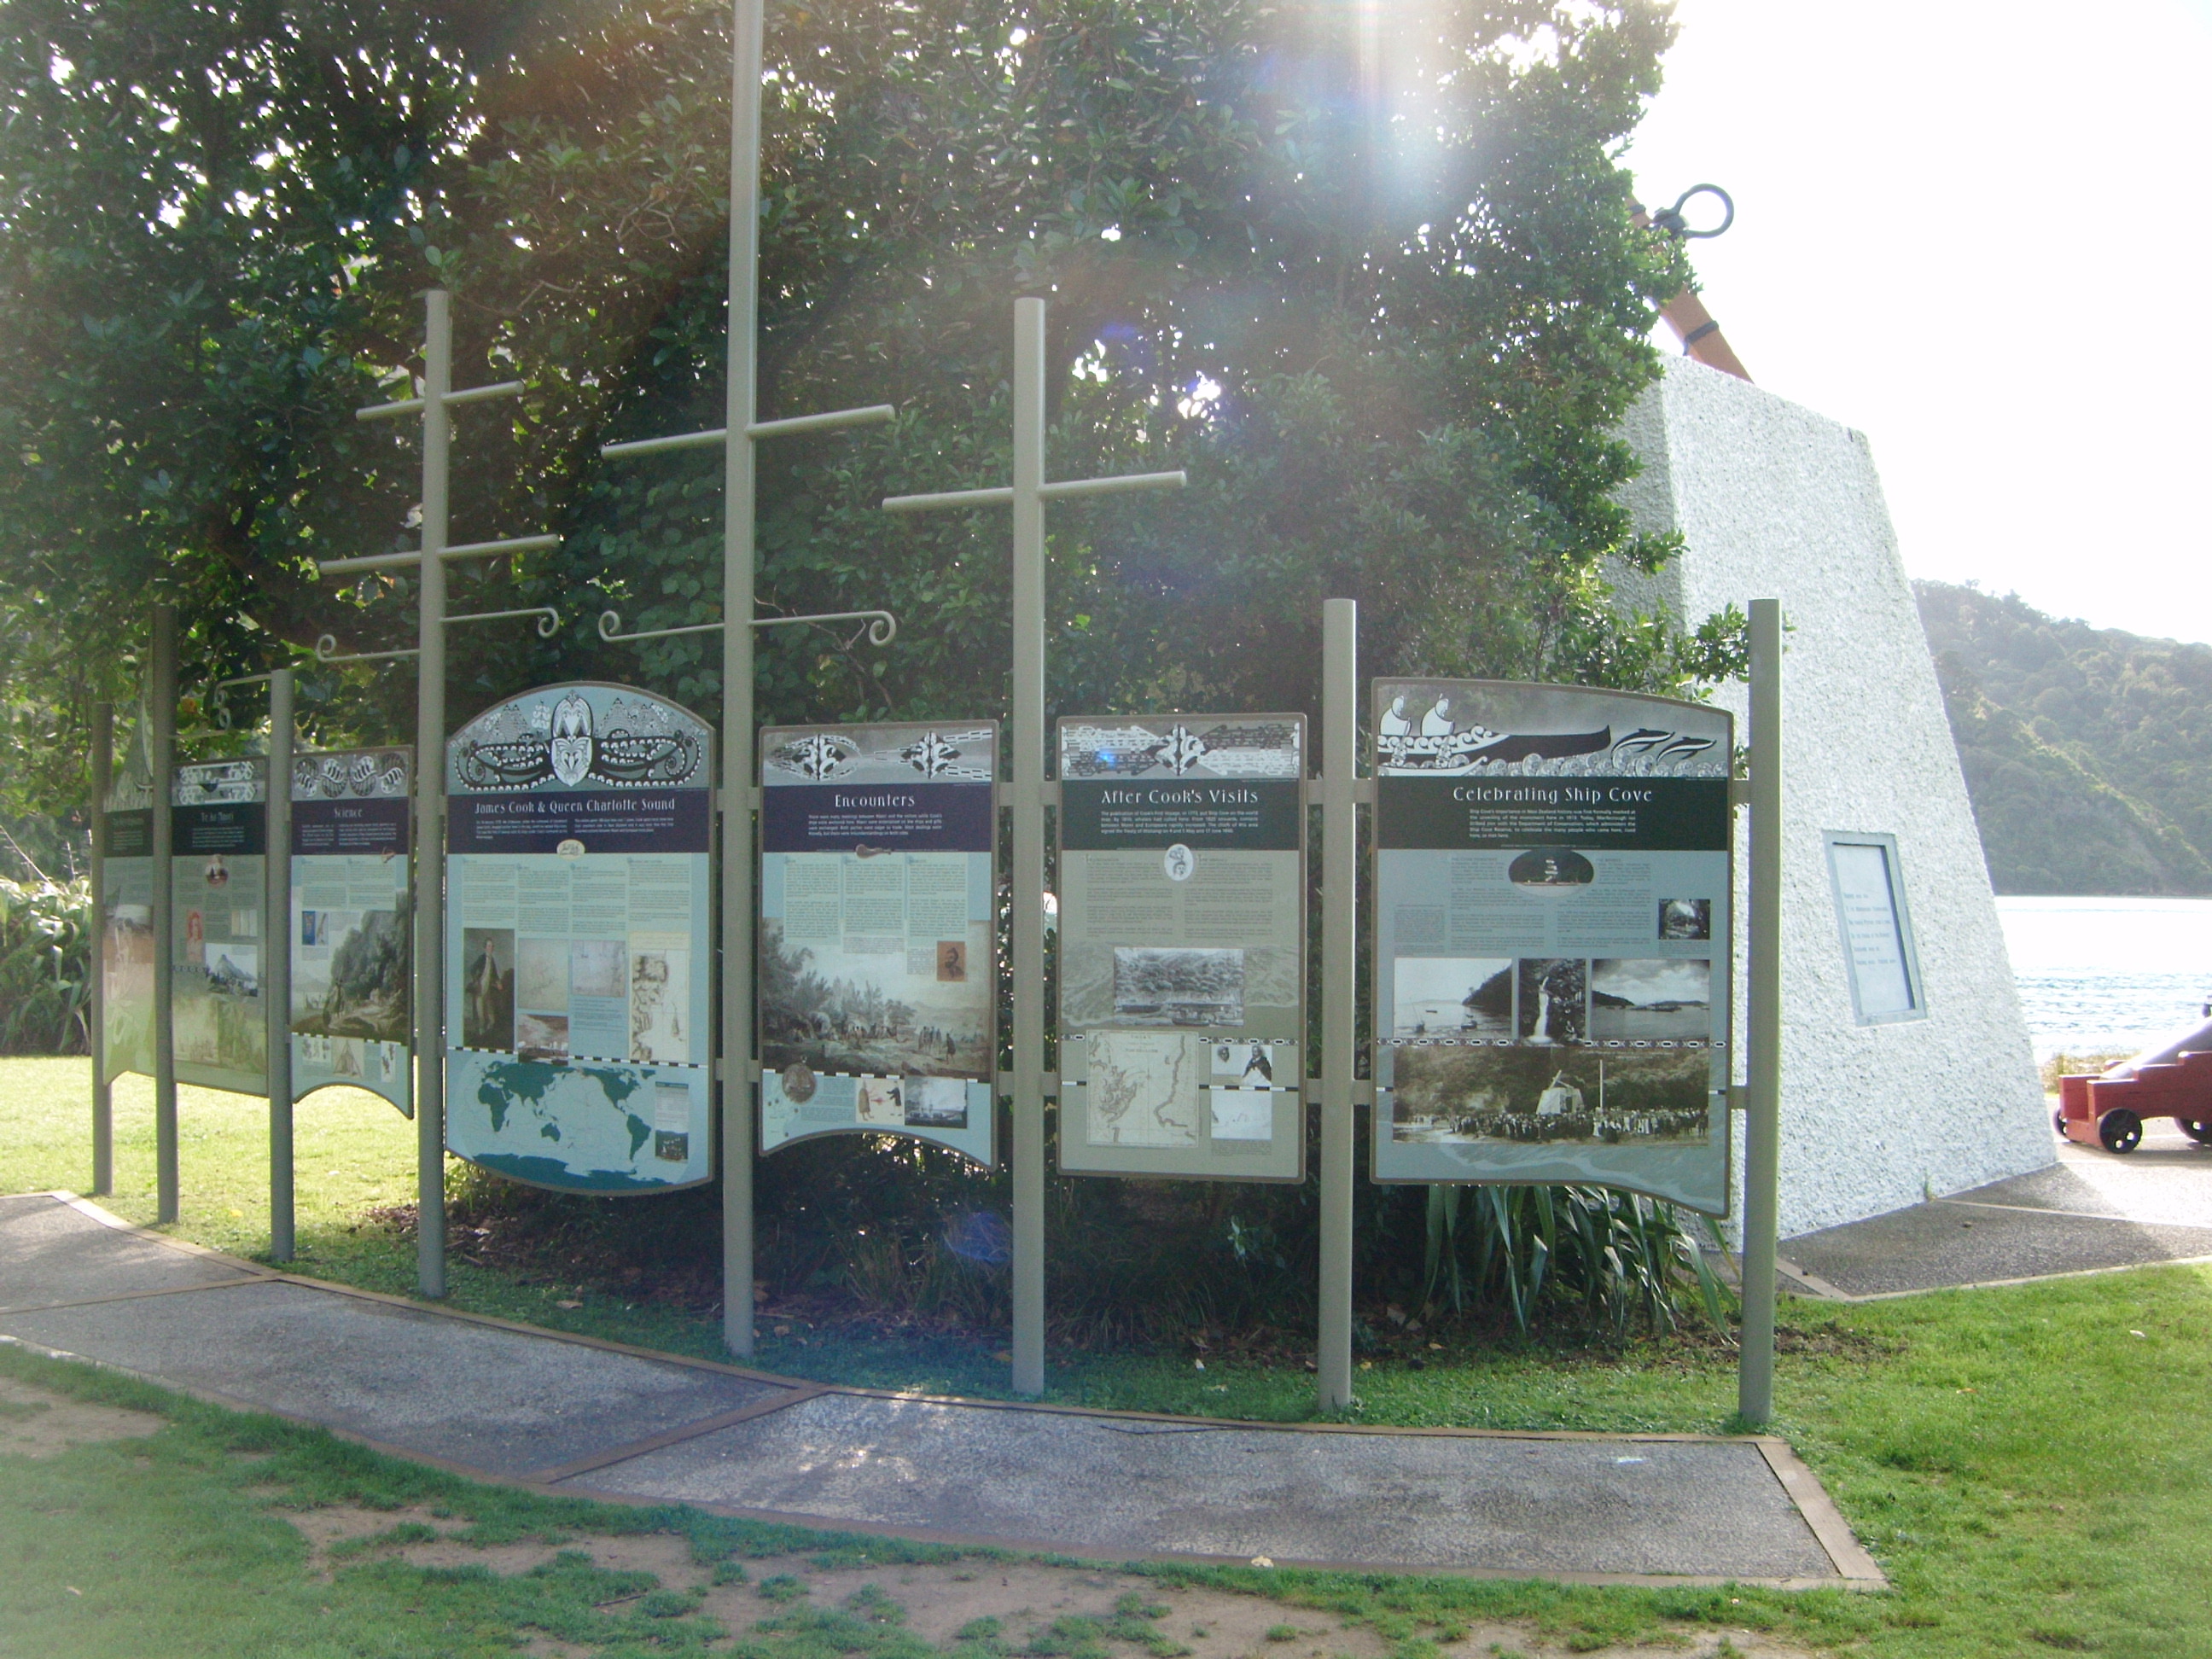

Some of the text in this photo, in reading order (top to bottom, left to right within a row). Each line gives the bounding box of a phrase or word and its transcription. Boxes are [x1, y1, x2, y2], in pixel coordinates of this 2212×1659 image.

[835, 794, 916, 807] Encounters
[1101, 789, 1259, 804] After Cook's Visits
[1452, 786, 1652, 804] Celebrating Ship Cove
[334, 807, 363, 818] Science
[474, 798, 675, 815] James Cook & Queen Charlotte Sound
